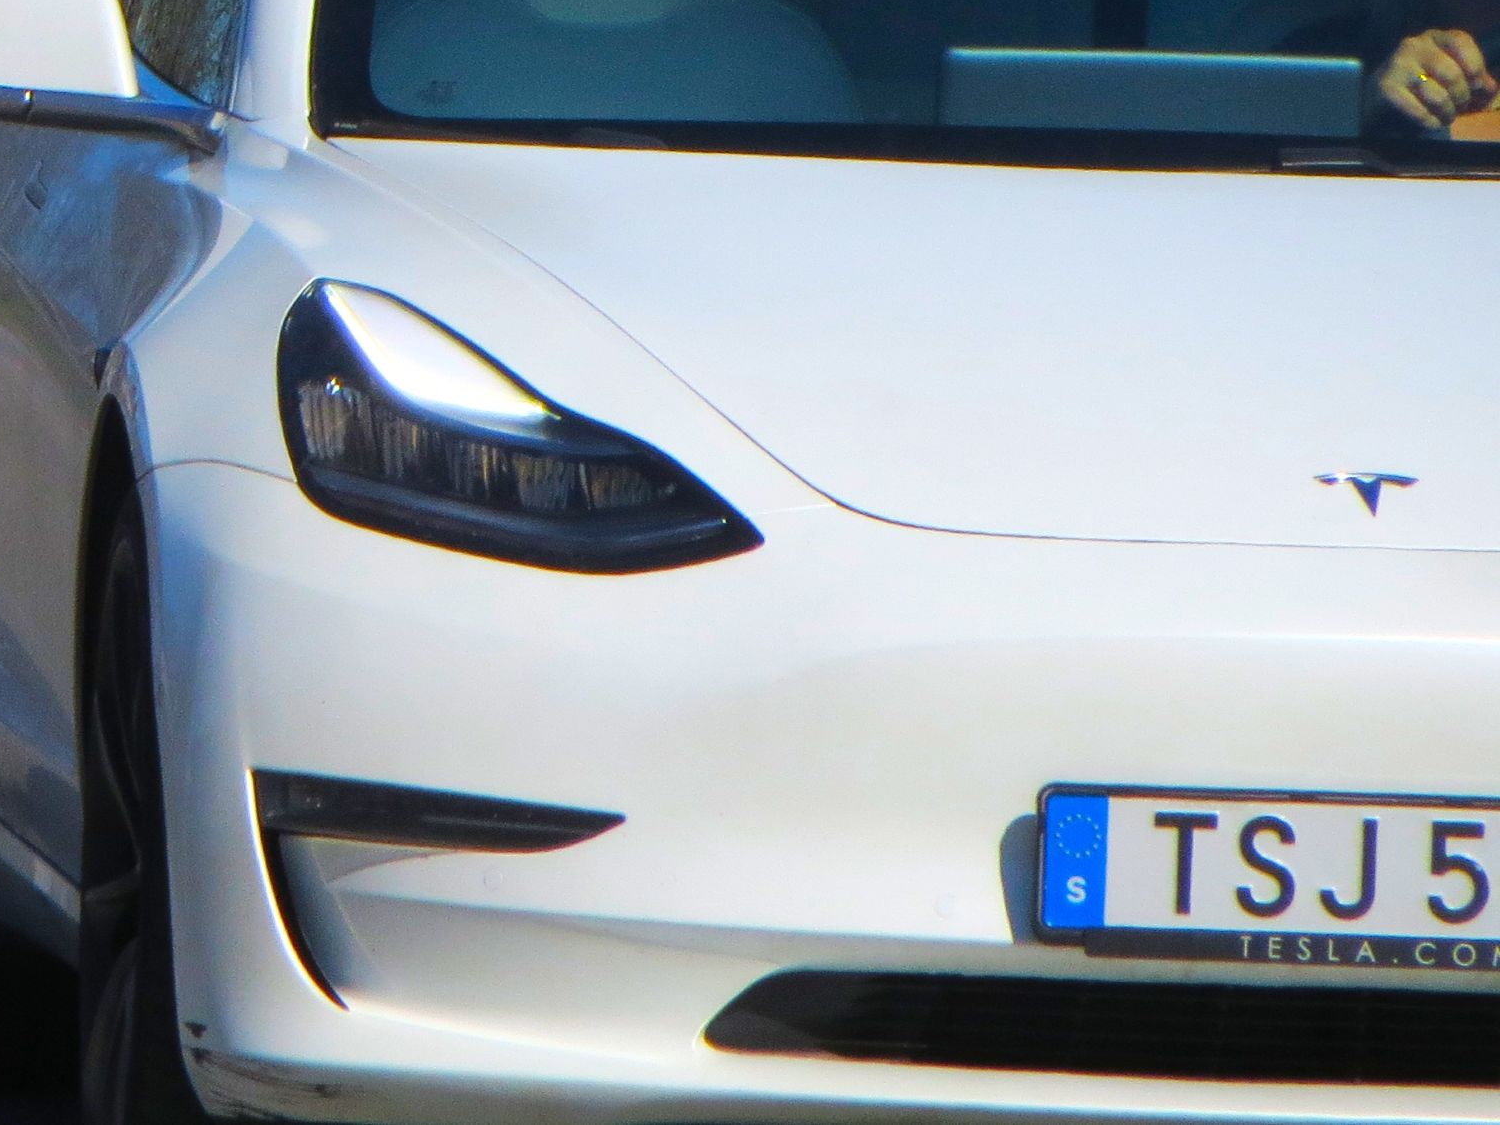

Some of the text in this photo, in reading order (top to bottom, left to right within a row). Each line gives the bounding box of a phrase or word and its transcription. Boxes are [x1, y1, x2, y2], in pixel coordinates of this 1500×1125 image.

[1066, 876, 1088, 904] S
[1153, 811, 1490, 925] TSJ 5
